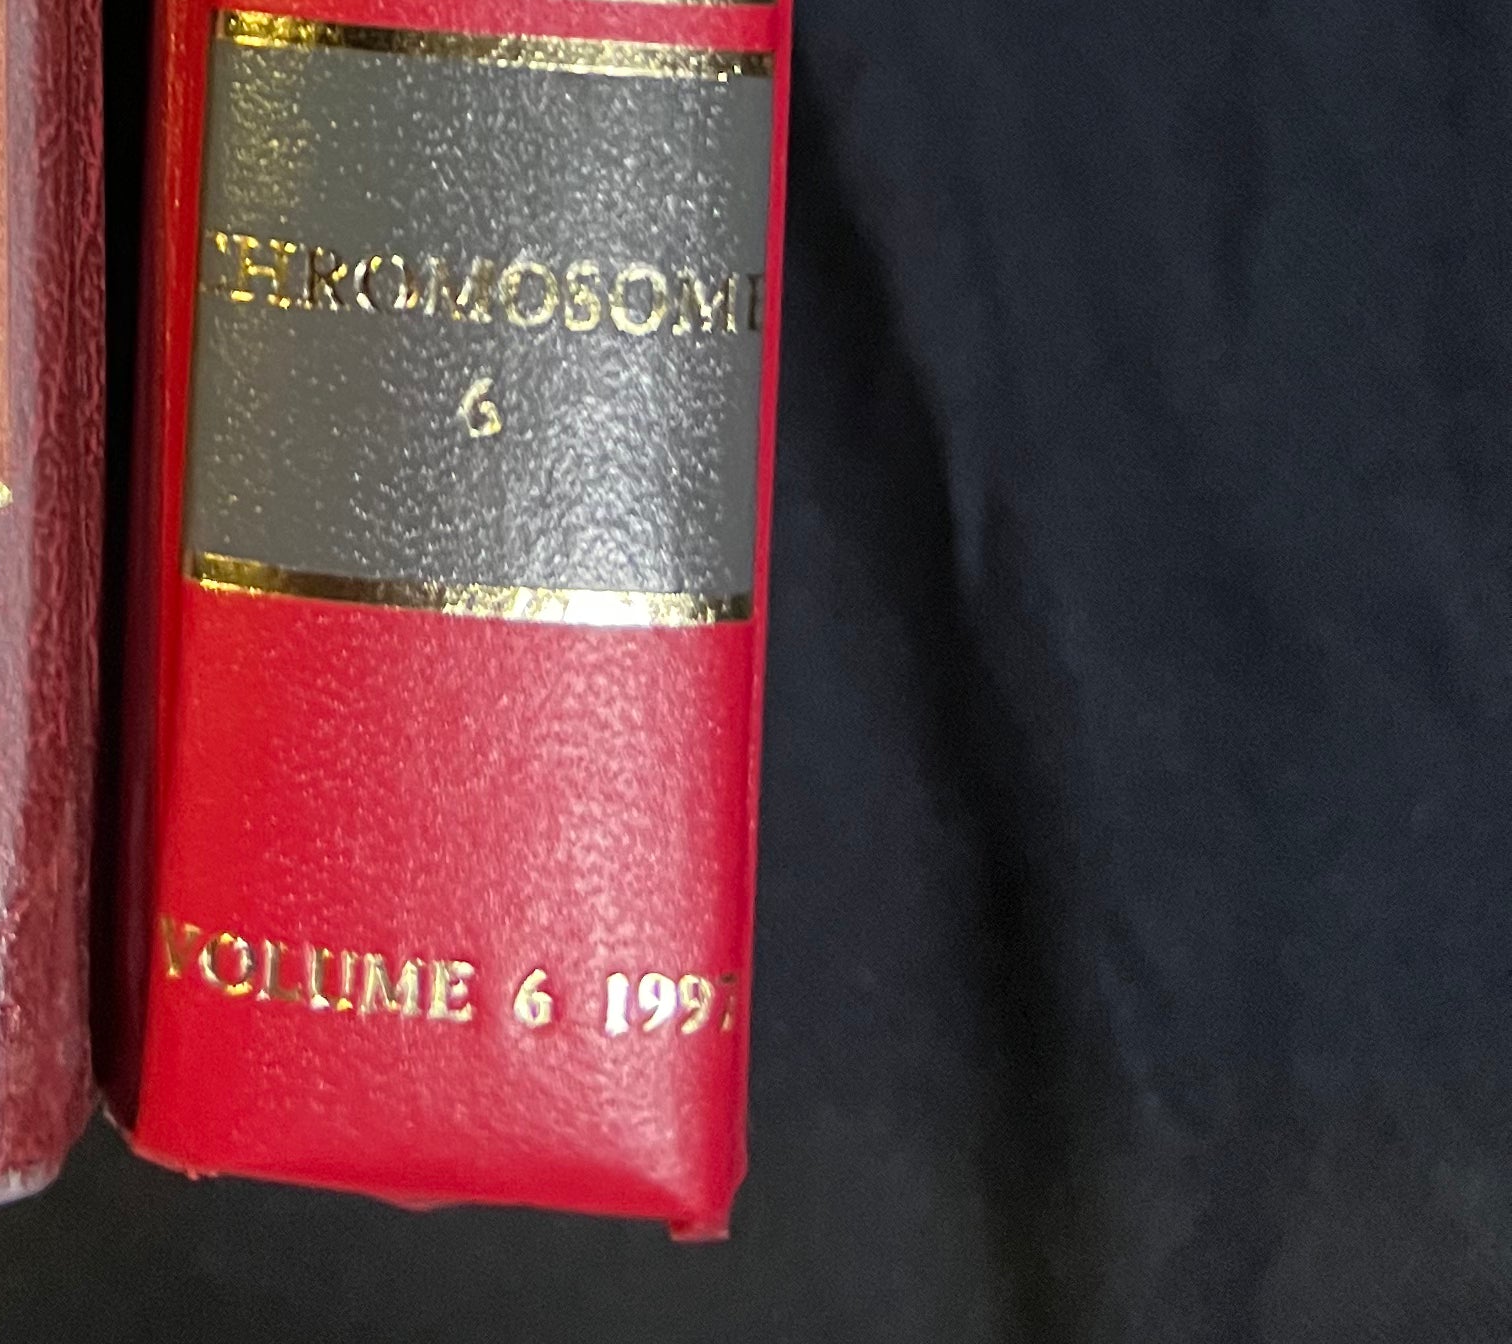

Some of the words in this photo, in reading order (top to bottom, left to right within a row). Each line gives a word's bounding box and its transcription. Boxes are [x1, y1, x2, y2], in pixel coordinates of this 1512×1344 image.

[458, 377, 501, 438] 6
[159, 915, 475, 1024] VOLUME
[512, 967, 554, 1028] 6
